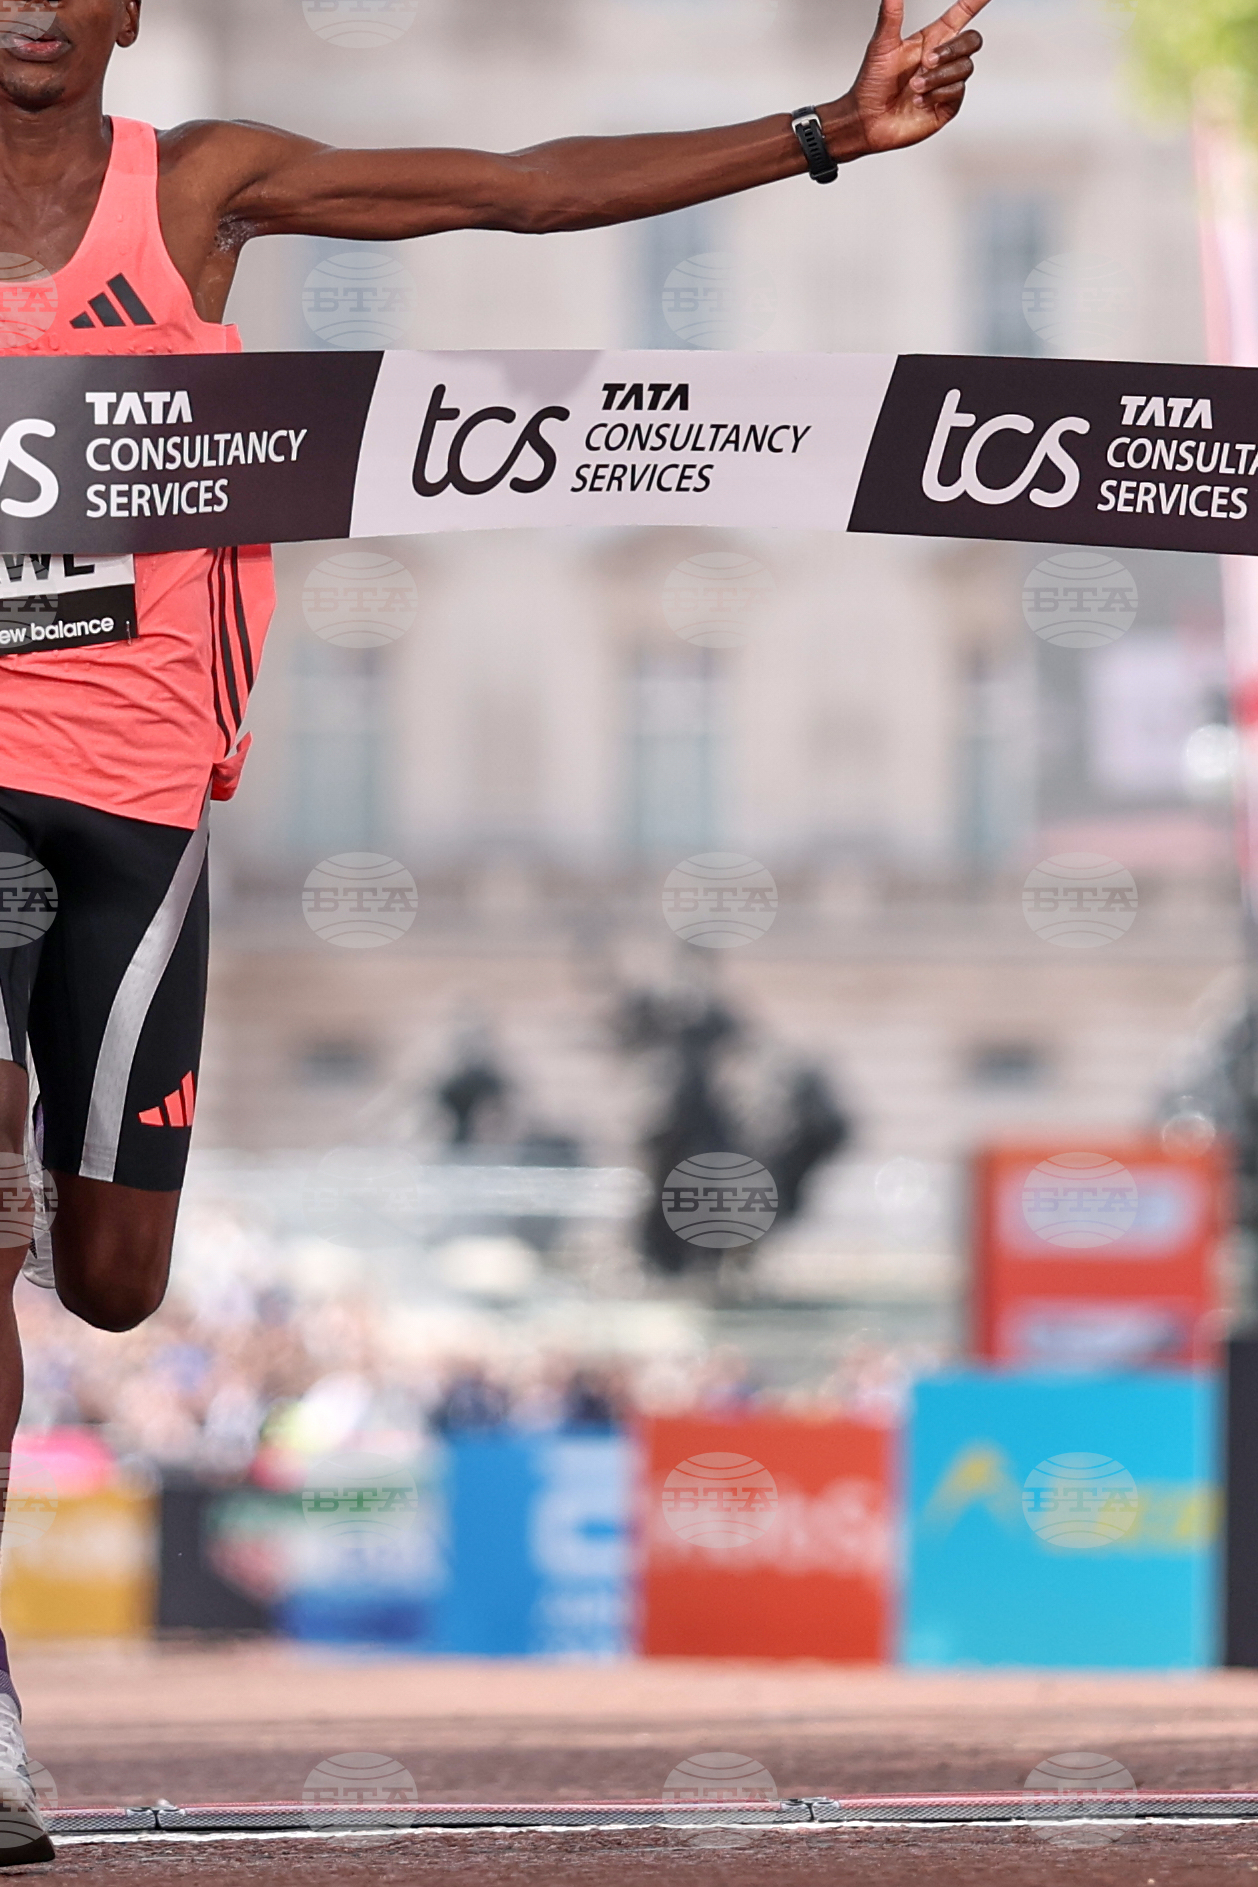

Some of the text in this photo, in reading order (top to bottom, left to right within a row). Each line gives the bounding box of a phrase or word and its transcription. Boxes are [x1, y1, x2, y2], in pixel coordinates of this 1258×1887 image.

[85, 391, 193, 425] TATA
[601, 383, 689, 411] TATA
[1120, 395, 1213, 430] TATA
[85, 429, 307, 472] CONSULTANCY
[412, 383, 570, 498] tcs
[585, 422, 812, 454] CONSULTANCY
[922, 388, 1091, 508] tcs
[570, 463, 715, 493] SERVICES
[86, 479, 229, 518] SERVICES
[1096, 479, 1249, 520] SERVICES
[31, 616, 115, 642] balance
